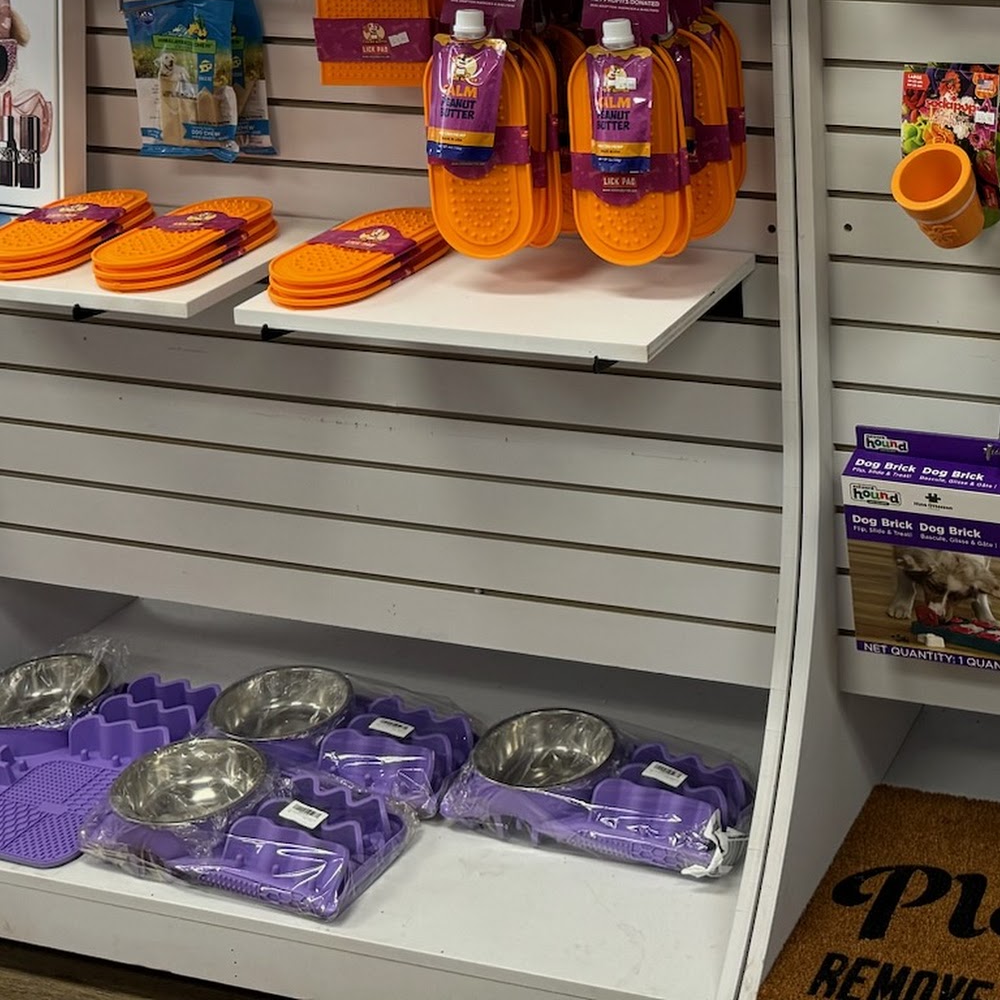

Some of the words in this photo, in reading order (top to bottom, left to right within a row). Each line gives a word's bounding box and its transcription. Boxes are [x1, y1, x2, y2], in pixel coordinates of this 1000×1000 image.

[630, 0, 660, 7] DONATED
[441, 98, 476, 110] PEANUT
[441, 109, 475, 120] BUTTER
[597, 111, 630, 120] PEANUT
[597, 121, 630, 131] BUTTER
[604, 177, 619, 186] LICK
[621, 177, 635, 186] PAD
[866, 438, 906, 451] hound
[855, 459, 881, 469] Dog
[884, 462, 916, 473] Brick
[922, 467, 948, 477] Dog
[951, 471, 984, 481] Brick
[854, 488, 899, 503] hound
[852, 514, 877, 526] Dog
[881, 518, 913, 530] Brick
[920, 523, 945, 535] Dog
[949, 527, 981, 538] Brick
[864, 642, 888, 654] NET
[891, 647, 956, 664] QUANTITY:
[959, 656, 964, 664] 1
